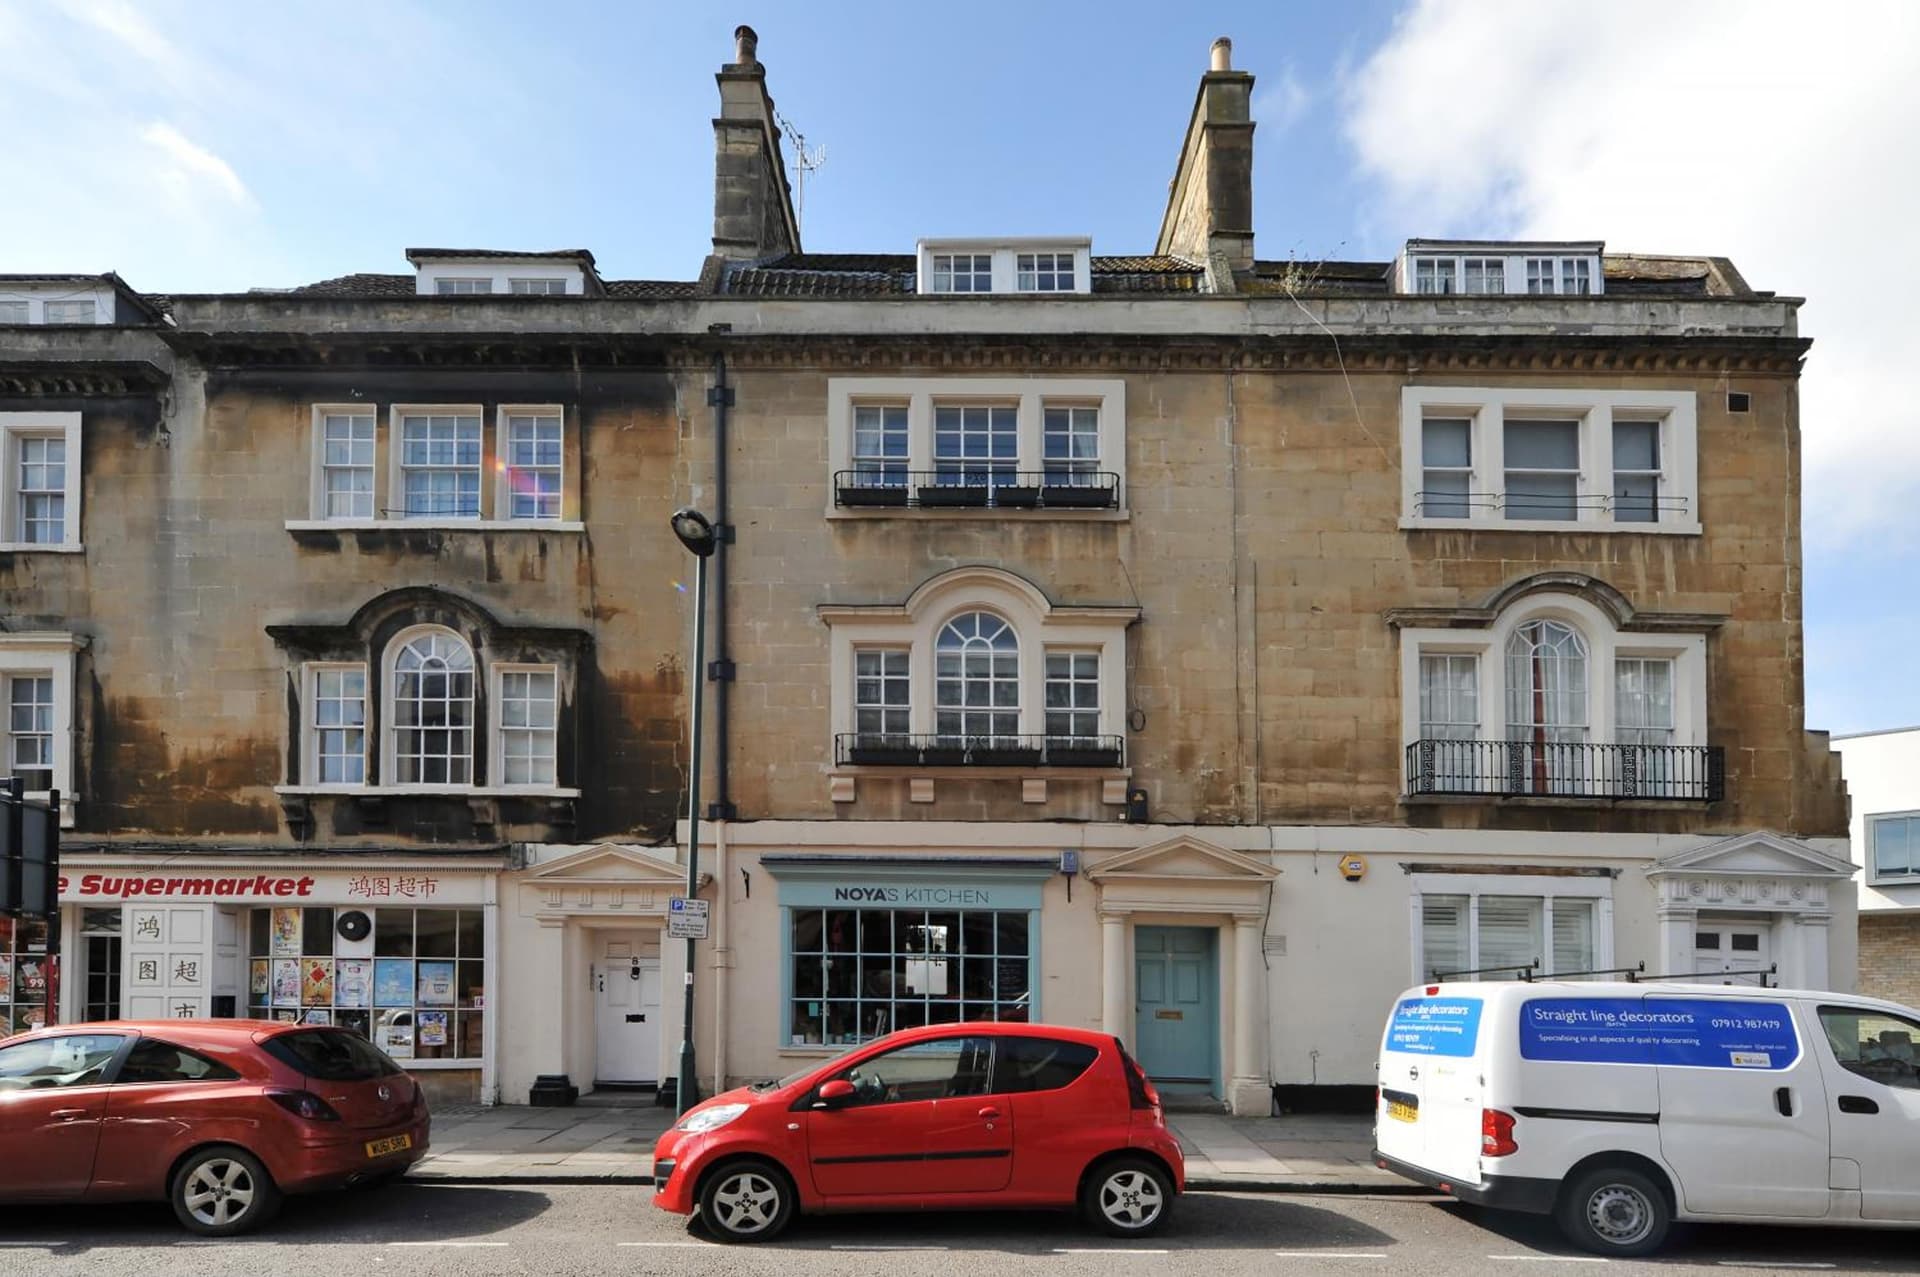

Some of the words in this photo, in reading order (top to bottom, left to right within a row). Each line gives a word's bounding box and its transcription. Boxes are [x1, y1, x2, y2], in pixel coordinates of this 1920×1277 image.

[79, 874, 315, 898] Supermarket
[348, 875, 439, 899] 鸿图超市
[835, 887, 898, 902] NOYA'S
[905, 888, 989, 904] KITCHEN
[1429, 1004, 1468, 1015] decorators
[1533, 1007, 1588, 1024] Straight
[1590, 1009, 1616, 1023] line
[1619, 1010, 1695, 1024] decorators
[1711, 1018, 1743, 1029] 07912
[1538, 1034, 1579, 1043] Specialising
[1599, 1035, 1626, 1044] aspects
[1627, 1035, 1634, 1043] of
[1662, 1036, 1701, 1047] decorating
